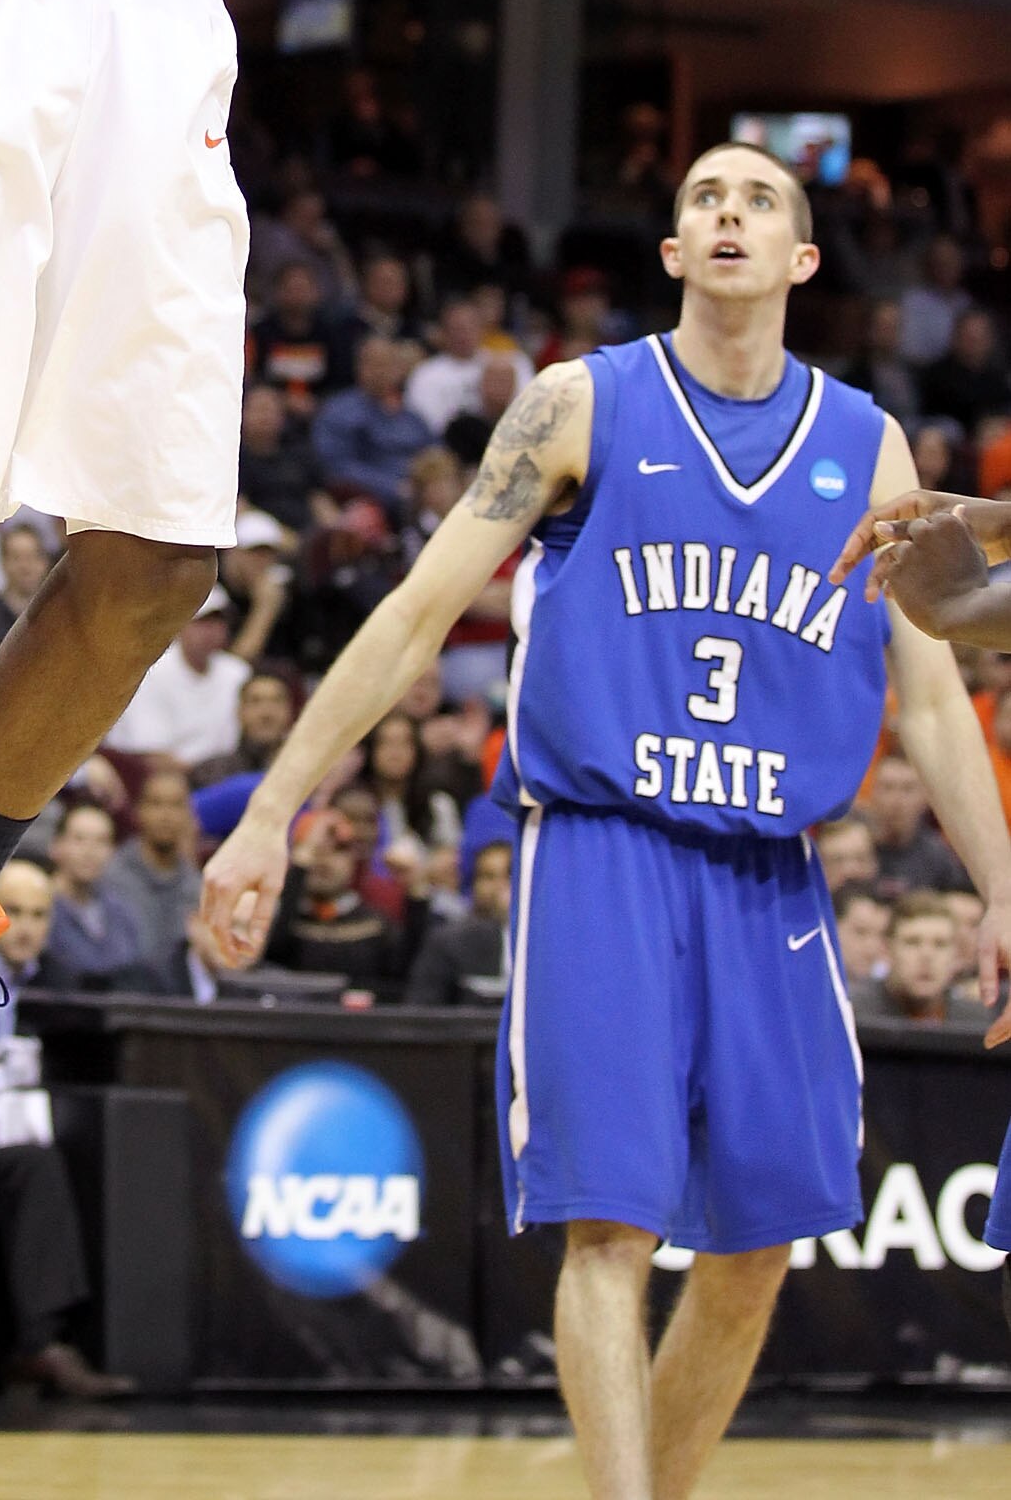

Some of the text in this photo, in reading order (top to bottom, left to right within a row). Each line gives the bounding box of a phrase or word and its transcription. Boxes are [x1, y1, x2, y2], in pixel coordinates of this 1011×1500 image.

[613, 542, 848, 653] INDIANA
[687, 634, 744, 725] 3
[634, 731, 787, 817] STATE
[241, 1173, 420, 1242] NCAA
